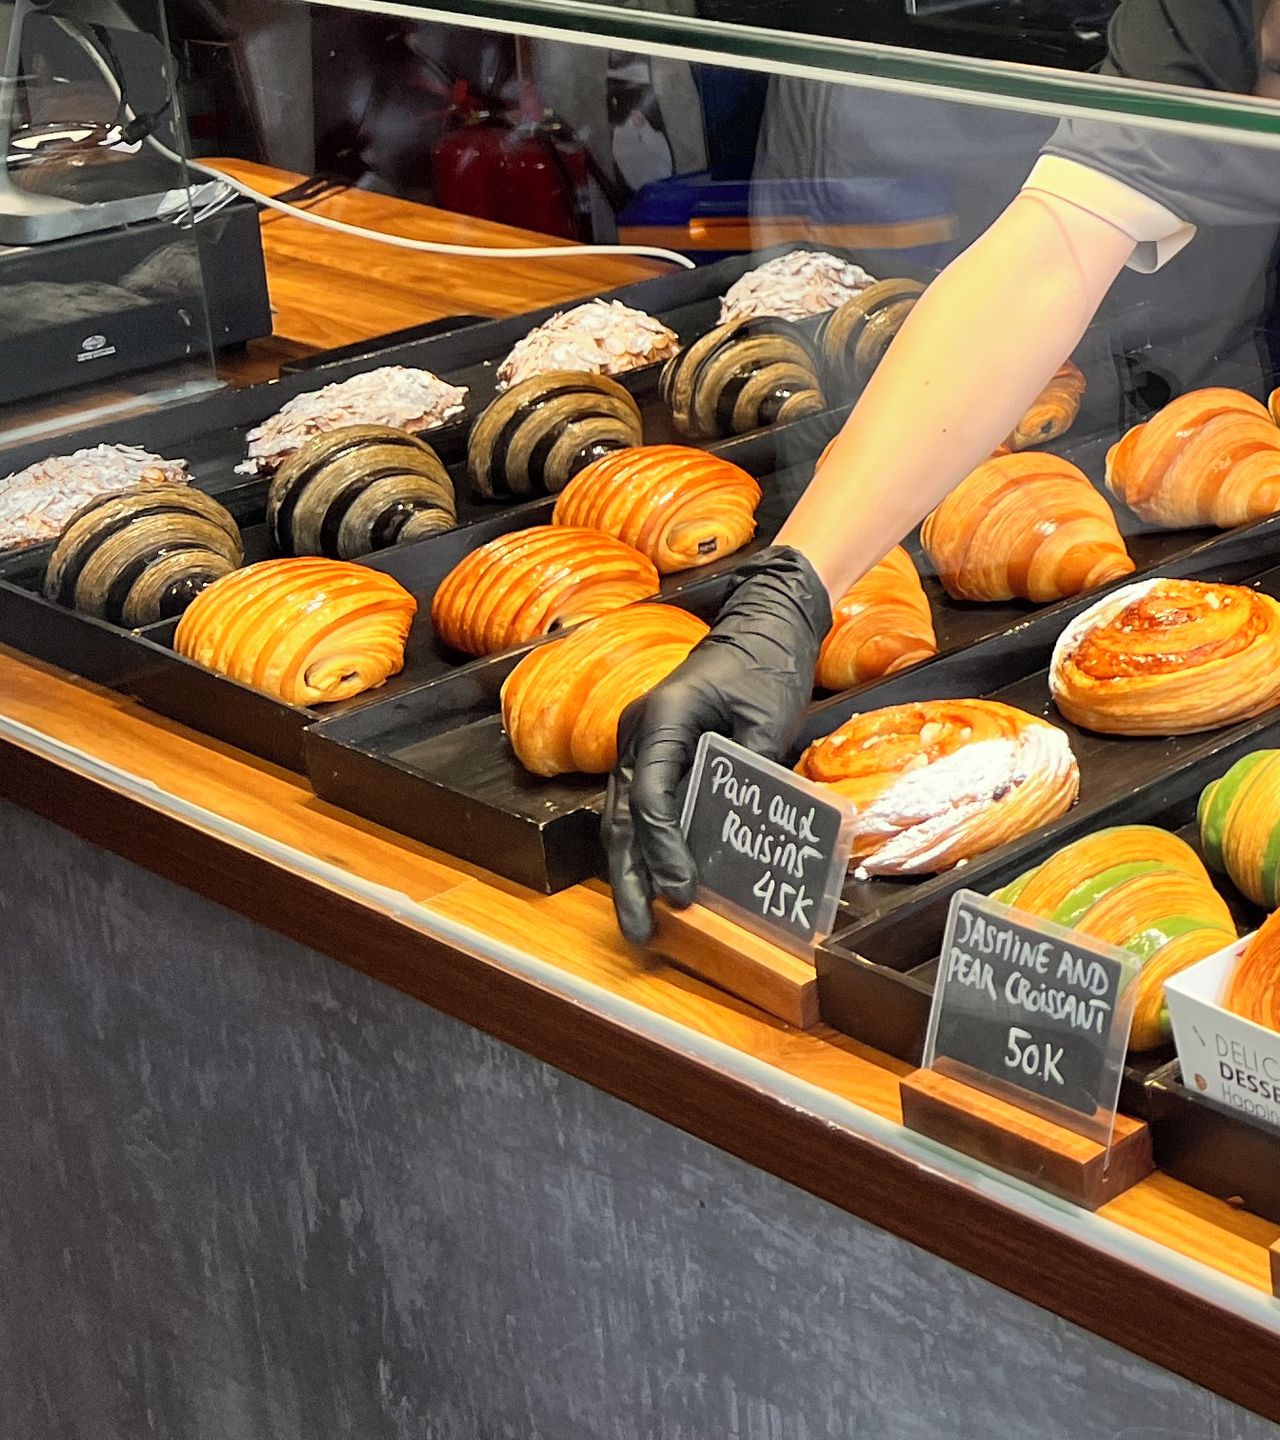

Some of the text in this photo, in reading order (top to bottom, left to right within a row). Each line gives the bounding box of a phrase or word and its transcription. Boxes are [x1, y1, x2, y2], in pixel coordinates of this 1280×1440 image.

[711, 756, 762, 815] Pain
[947, 946, 998, 1001] PEAR
[1056, 950, 1109, 995] AND
